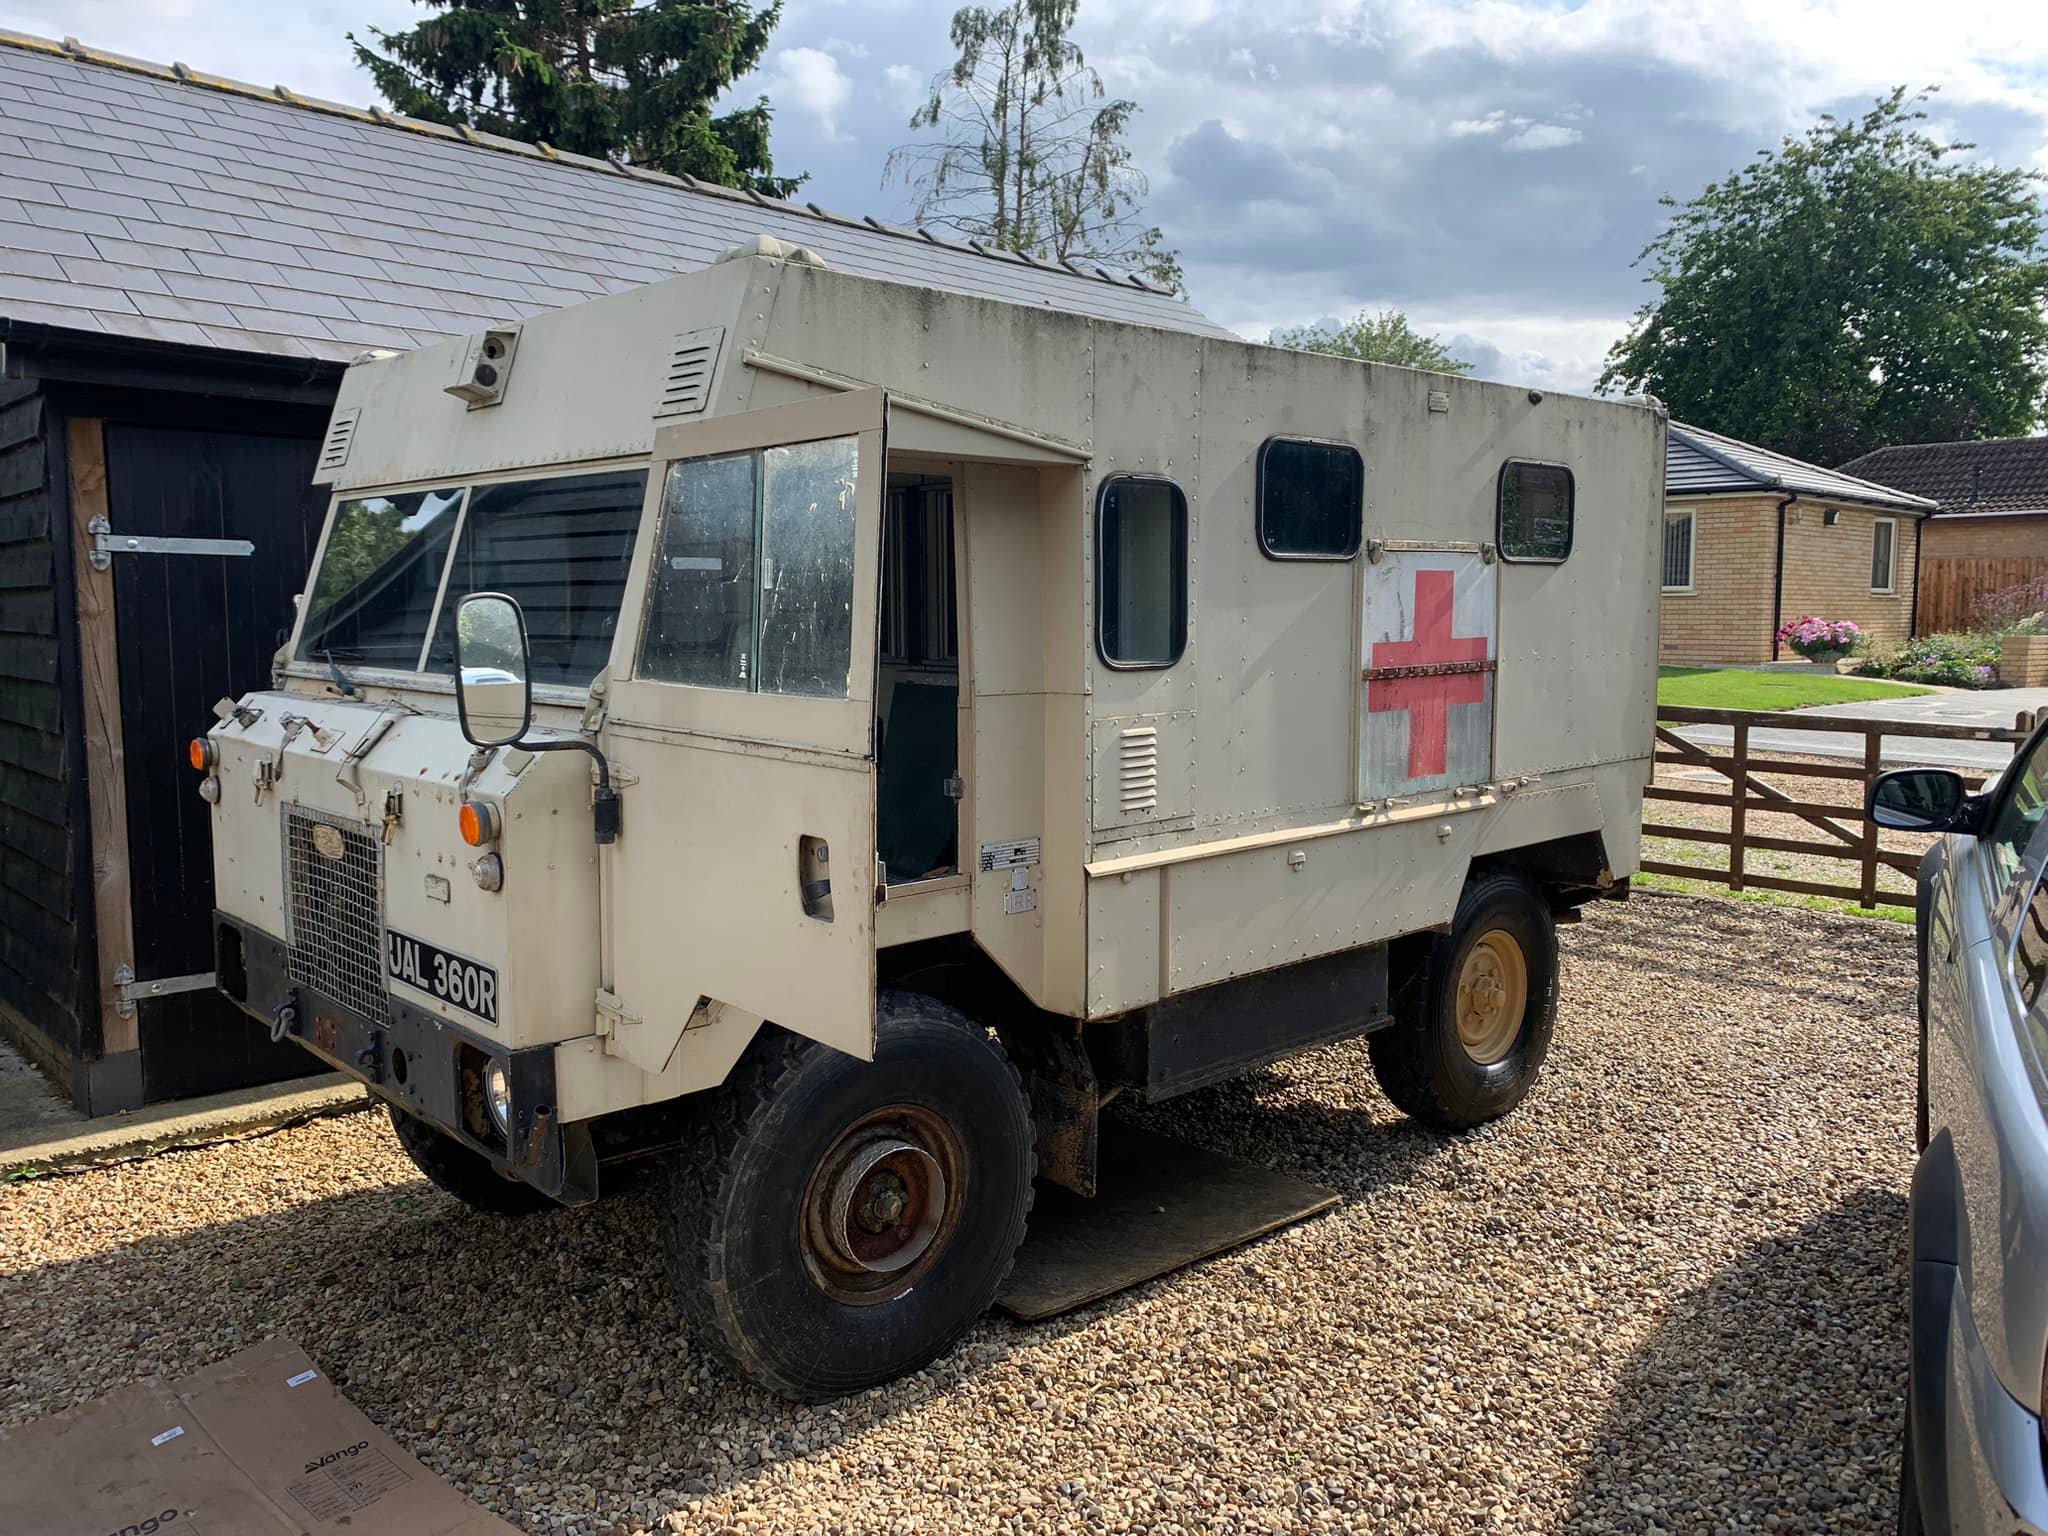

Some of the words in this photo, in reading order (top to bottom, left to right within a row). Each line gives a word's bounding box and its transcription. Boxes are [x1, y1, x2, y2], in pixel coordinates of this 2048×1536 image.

[387, 933, 429, 989] UAL
[433, 953, 496, 1019] 360R
[305, 1440, 369, 1474] Vango
[109, 1509, 178, 1536] ngo
